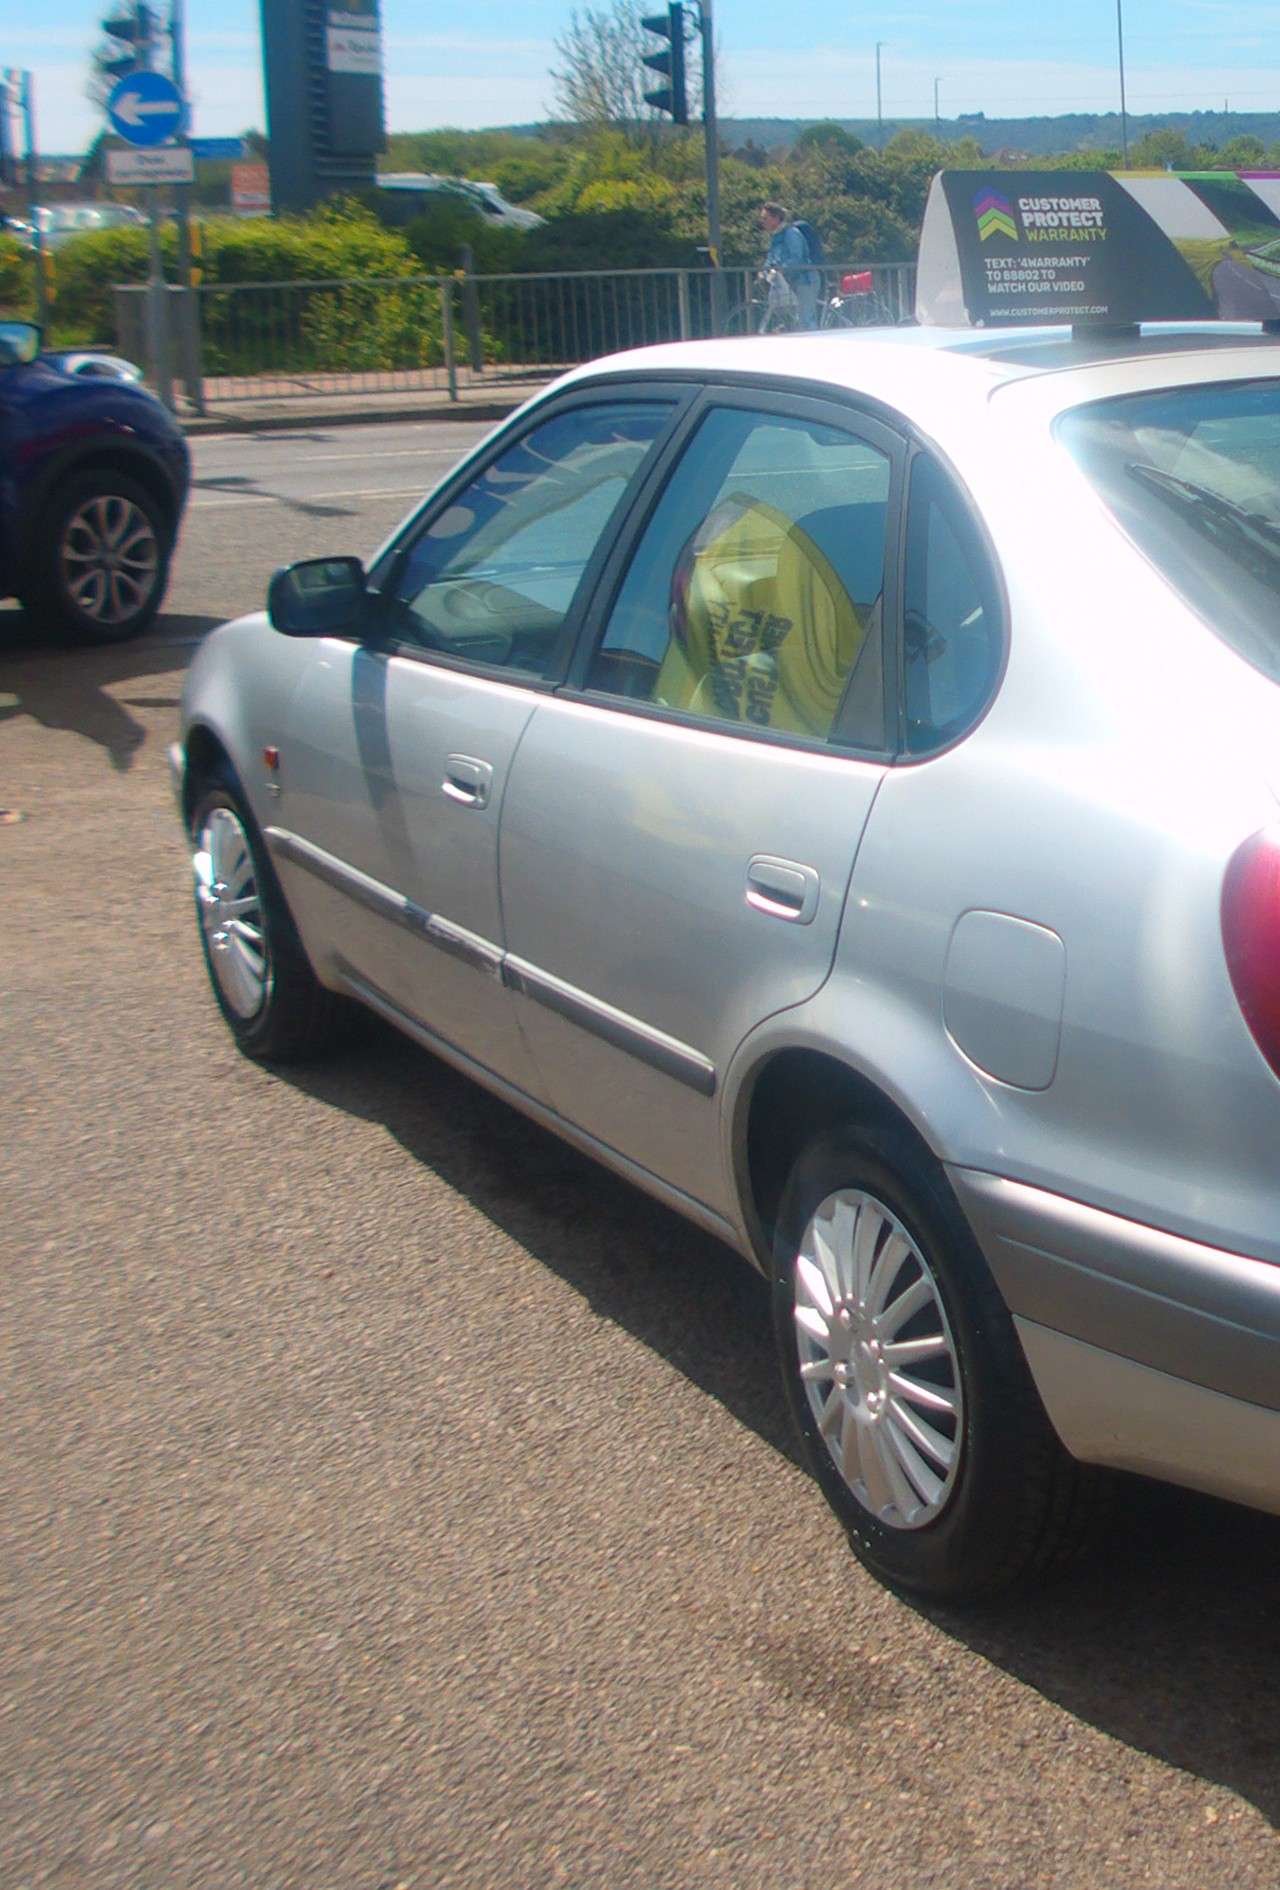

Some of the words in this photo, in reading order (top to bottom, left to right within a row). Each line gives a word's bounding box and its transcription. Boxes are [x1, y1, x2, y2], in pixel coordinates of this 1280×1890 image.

[1019, 198, 1101, 210] CUSTOMER
[1021, 212, 1103, 227] PROTECT
[1025, 228, 1107, 241] WARRANTY
[984, 258, 1016, 269] TEXT:
[986, 271, 1001, 281] TO
[1040, 270, 1056, 279] TO
[987, 282, 1026, 293] WATCH
[1028, 282, 1051, 292] OUR
[1053, 281, 1085, 292] VIDEO
